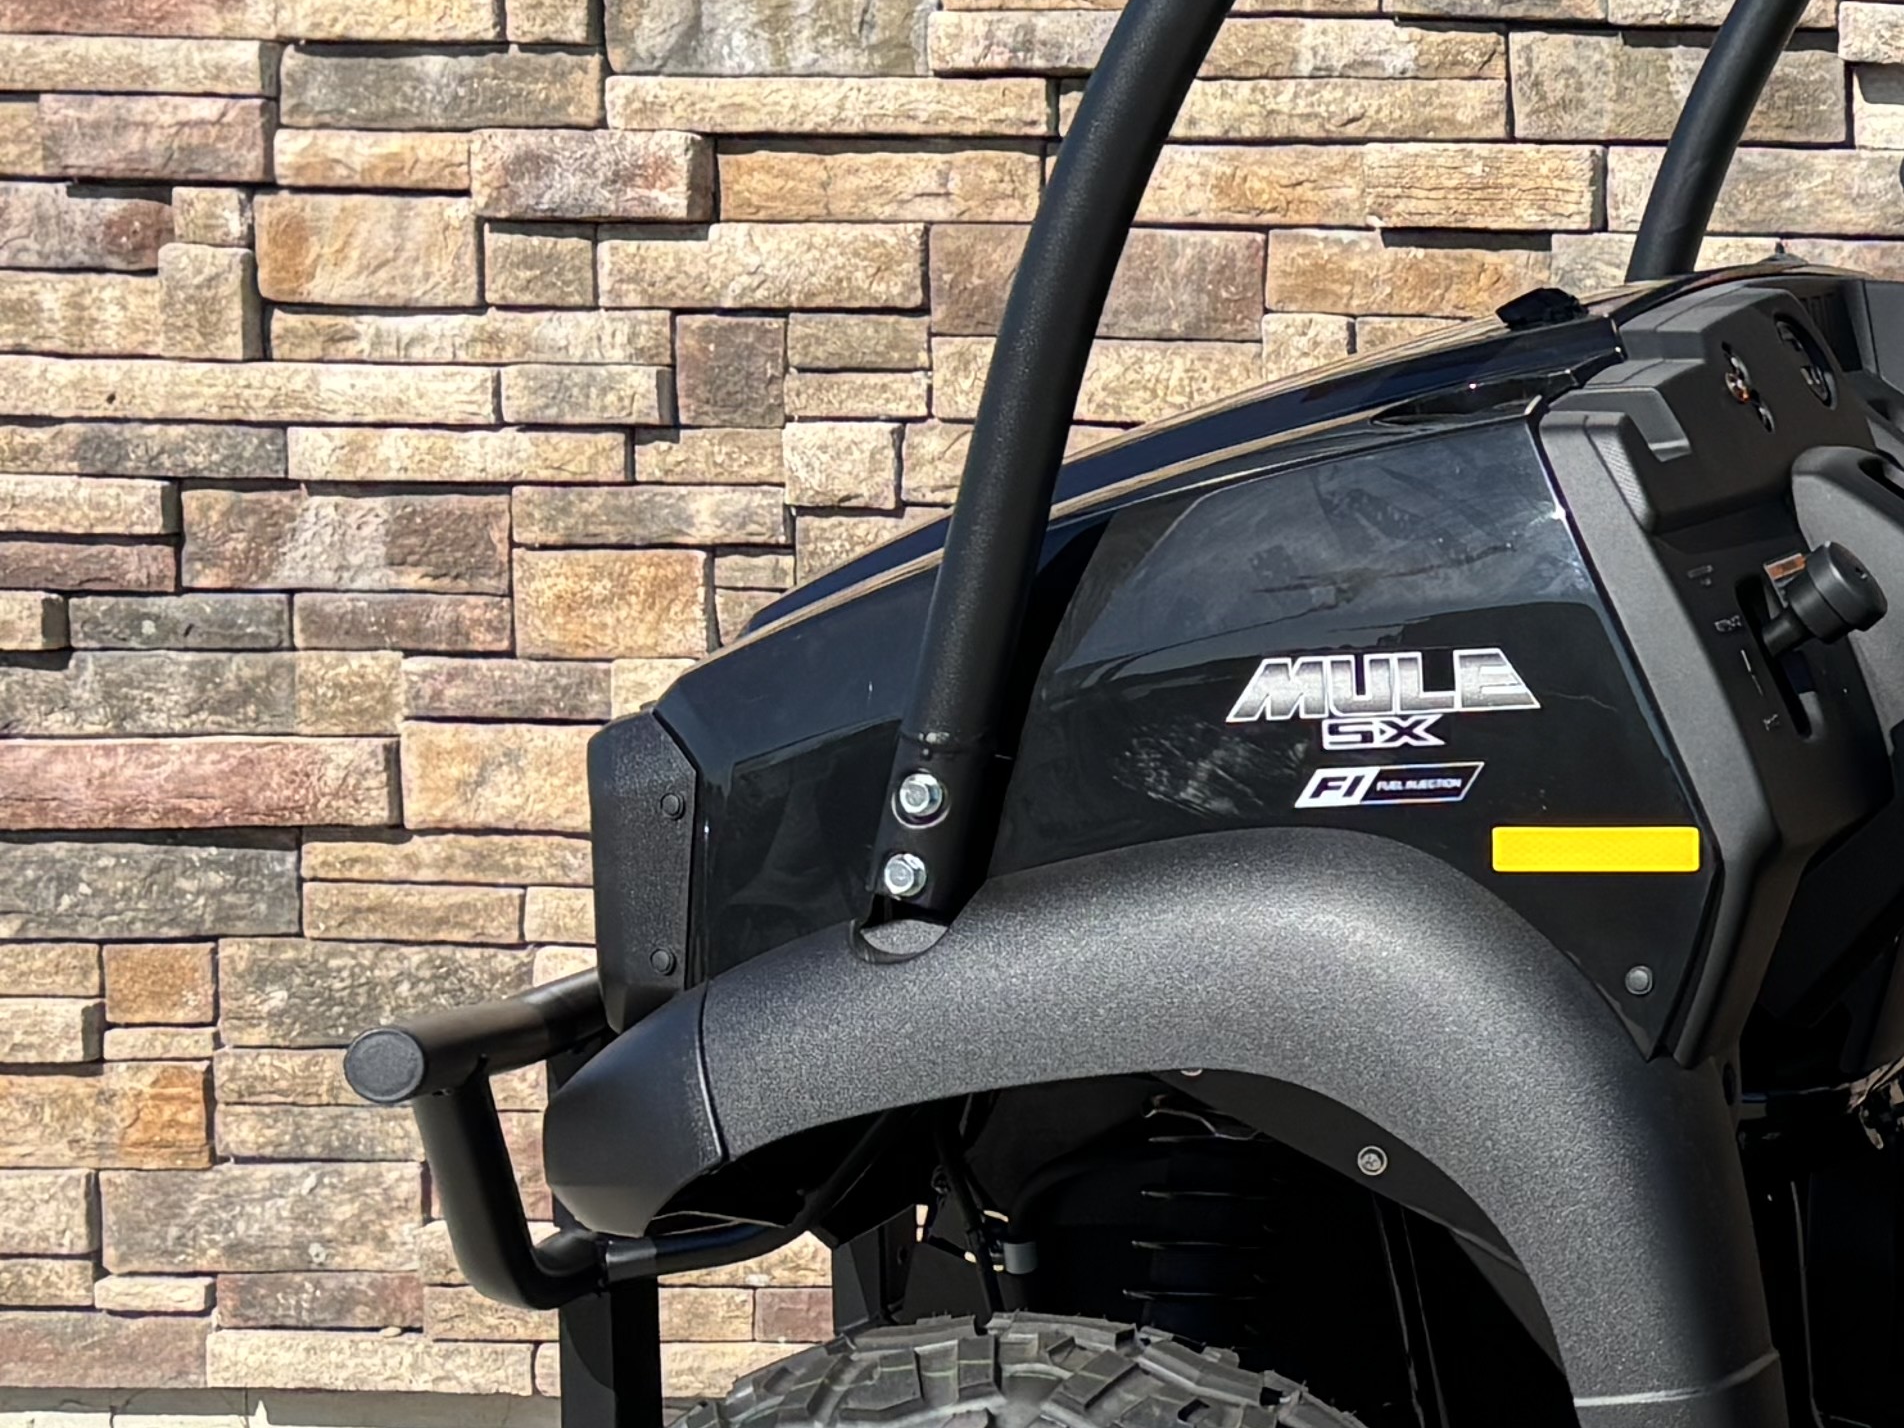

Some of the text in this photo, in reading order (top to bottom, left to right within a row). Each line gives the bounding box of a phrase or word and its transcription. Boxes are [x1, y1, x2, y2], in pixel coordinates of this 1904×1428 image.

[1226, 647, 1541, 722] MULE
[1322, 715, 1446, 750] SX
[1309, 775, 1365, 799] FI
[1376, 780, 1403, 791] FUEL
